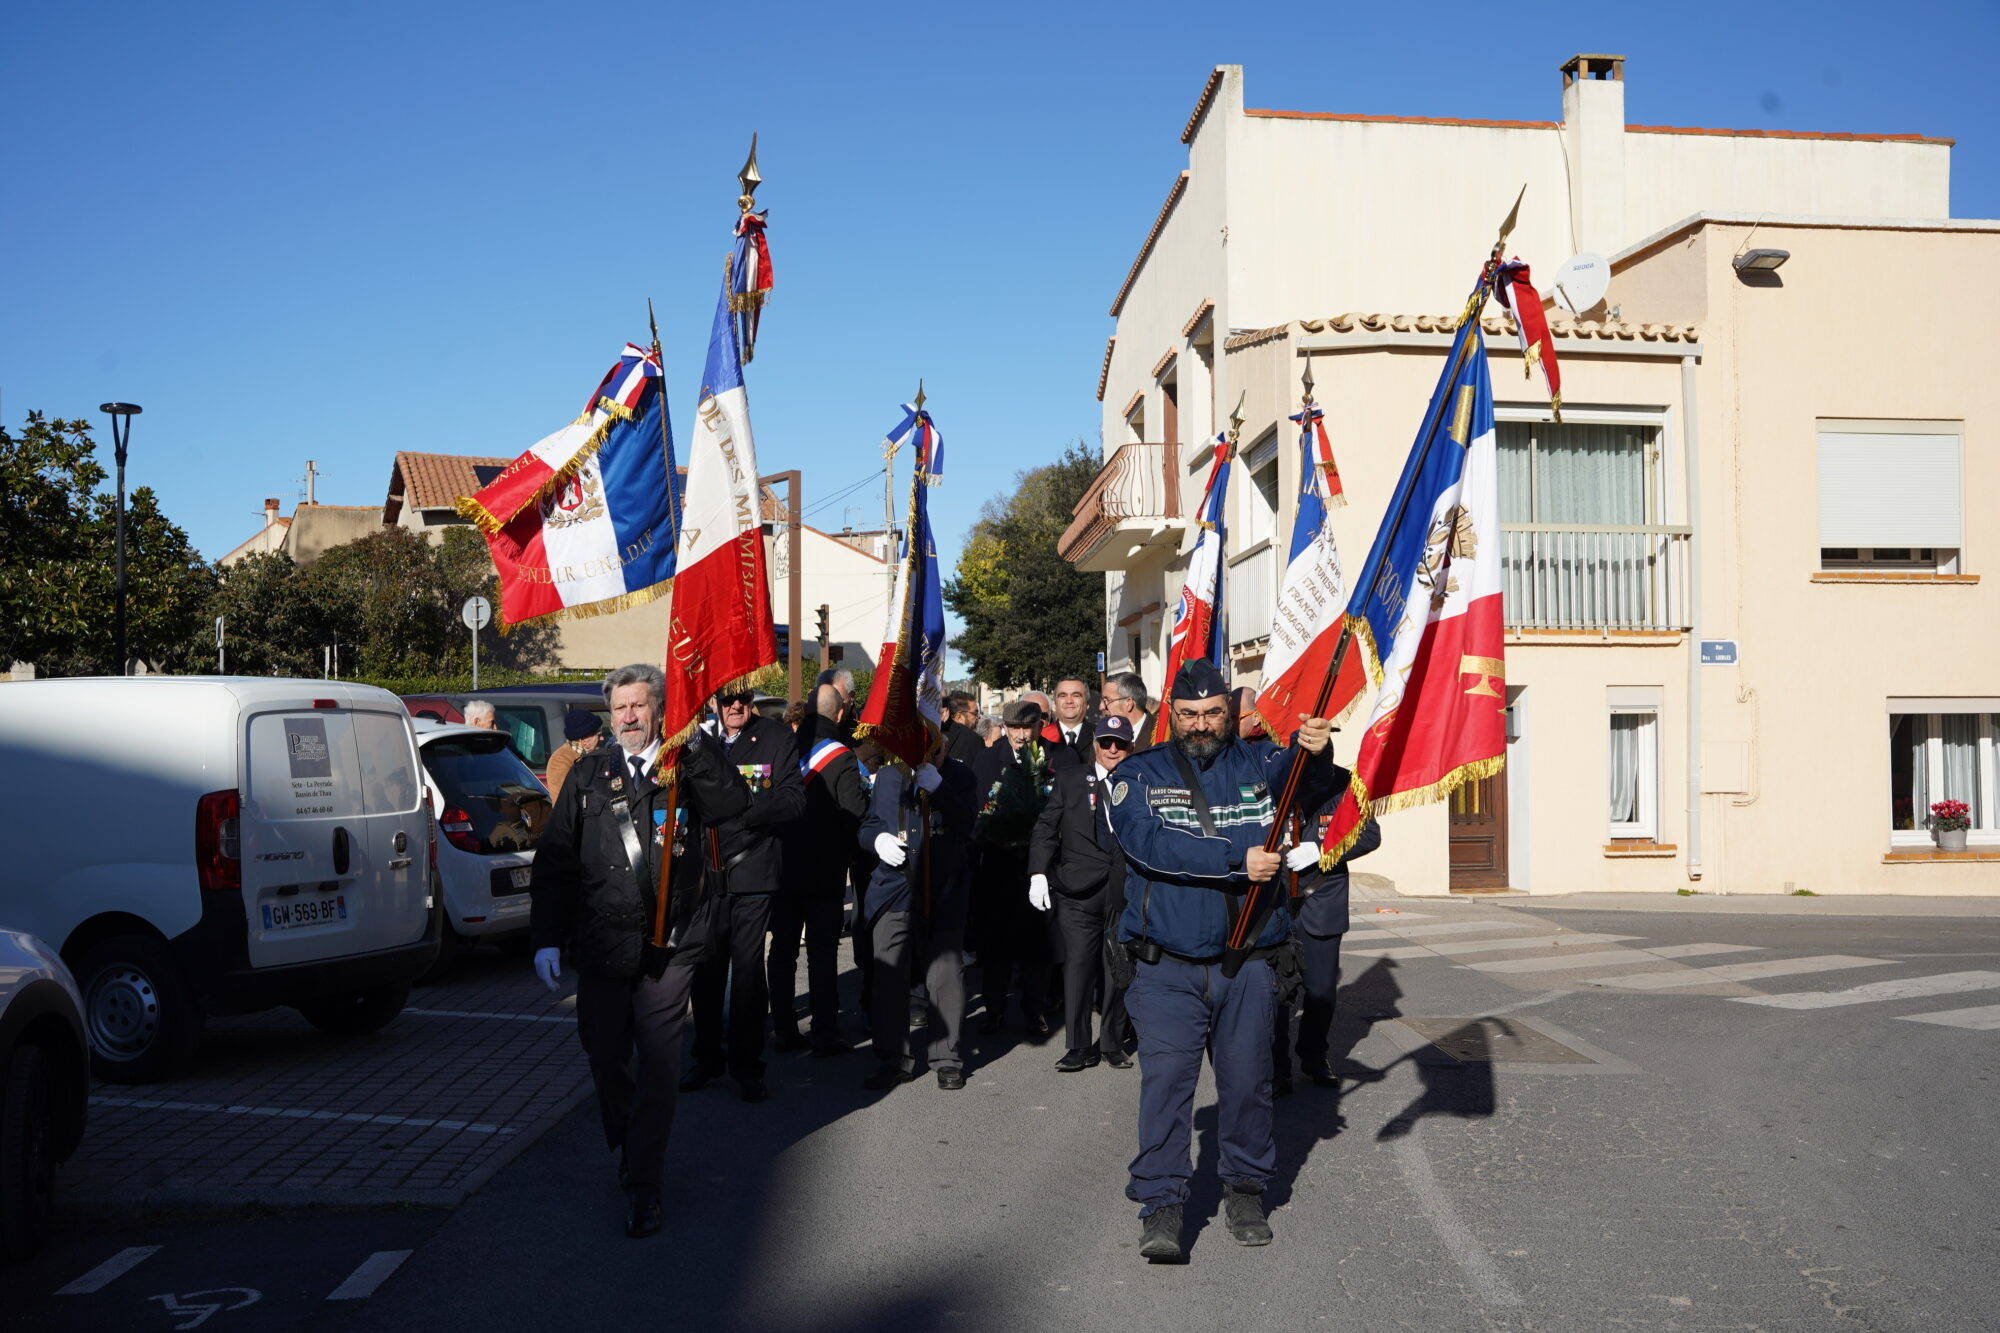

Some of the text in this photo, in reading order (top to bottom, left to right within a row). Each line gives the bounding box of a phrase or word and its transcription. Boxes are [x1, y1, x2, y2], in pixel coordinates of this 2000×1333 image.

[719, 438, 745, 484] DES
[1302, 577, 1327, 607] ITALIE
[1315, 563, 1339, 598] TUNISIE
[1288, 586, 1318, 622] FRANCE
[1150, 798, 1169, 806] POLICE
